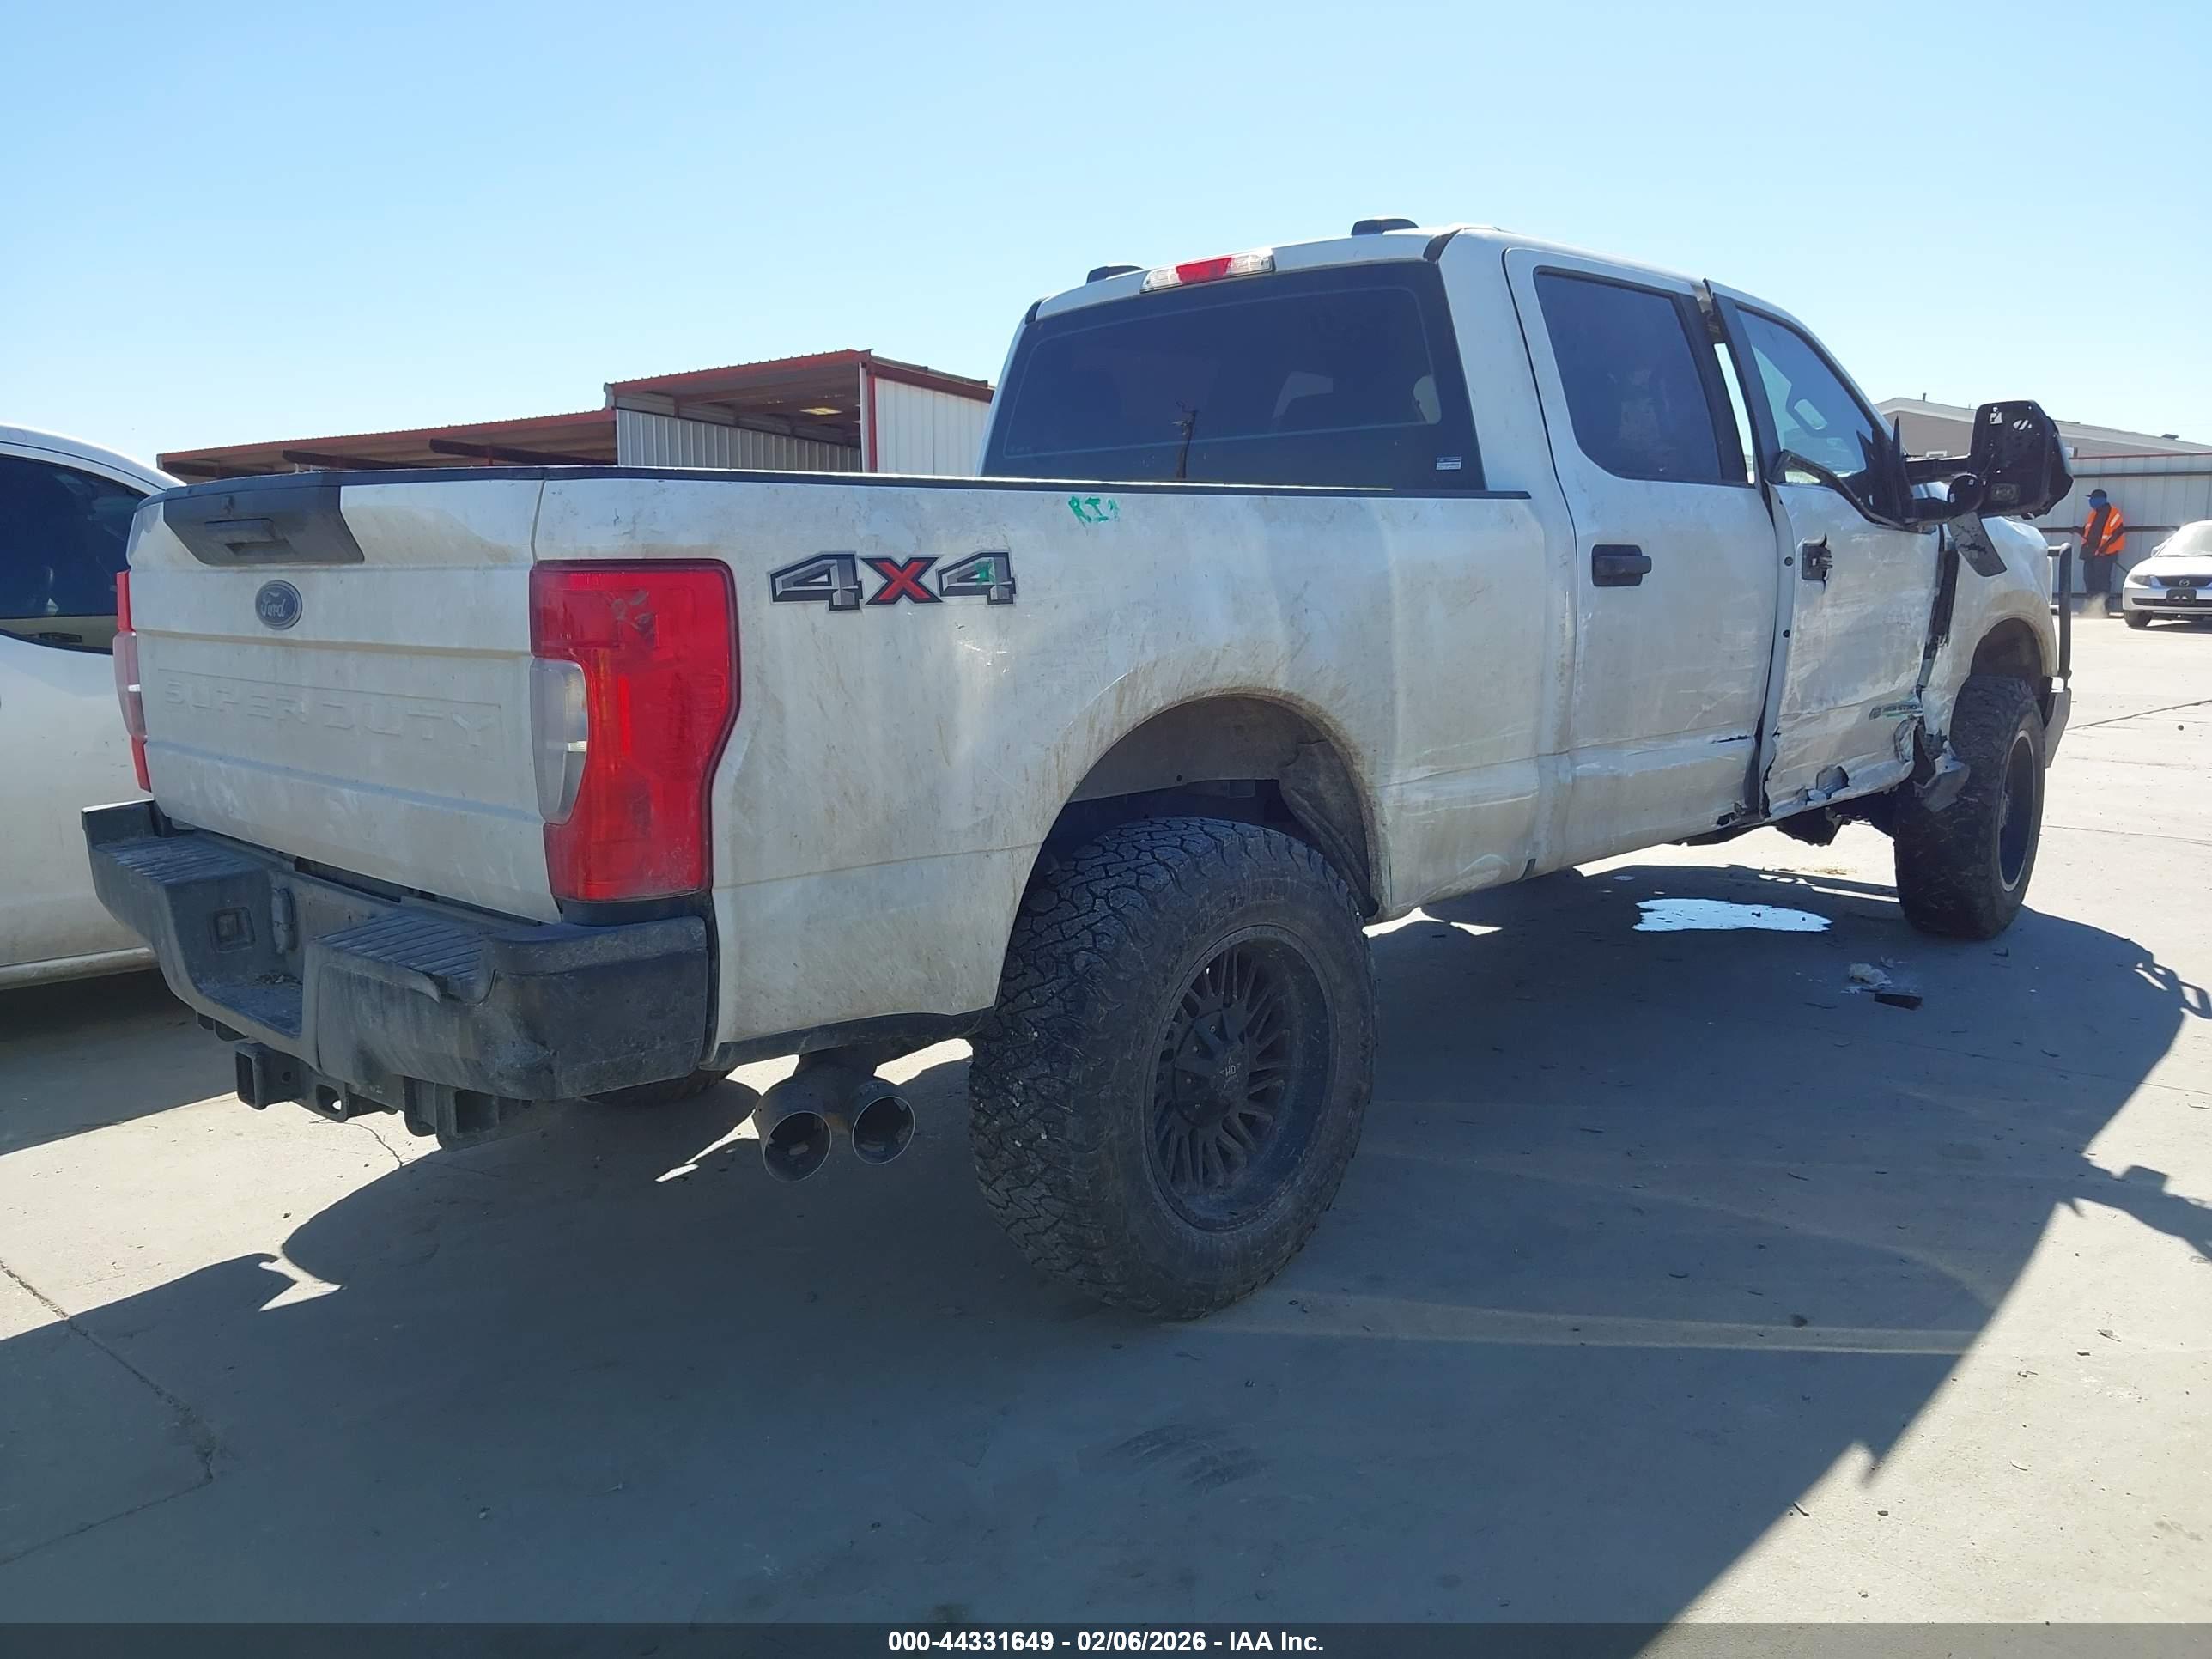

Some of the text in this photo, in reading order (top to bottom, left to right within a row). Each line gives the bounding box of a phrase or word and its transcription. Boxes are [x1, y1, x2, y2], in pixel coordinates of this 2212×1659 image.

[259, 590, 288, 617] Ford
[165, 678, 495, 747] SUPER DUTY
